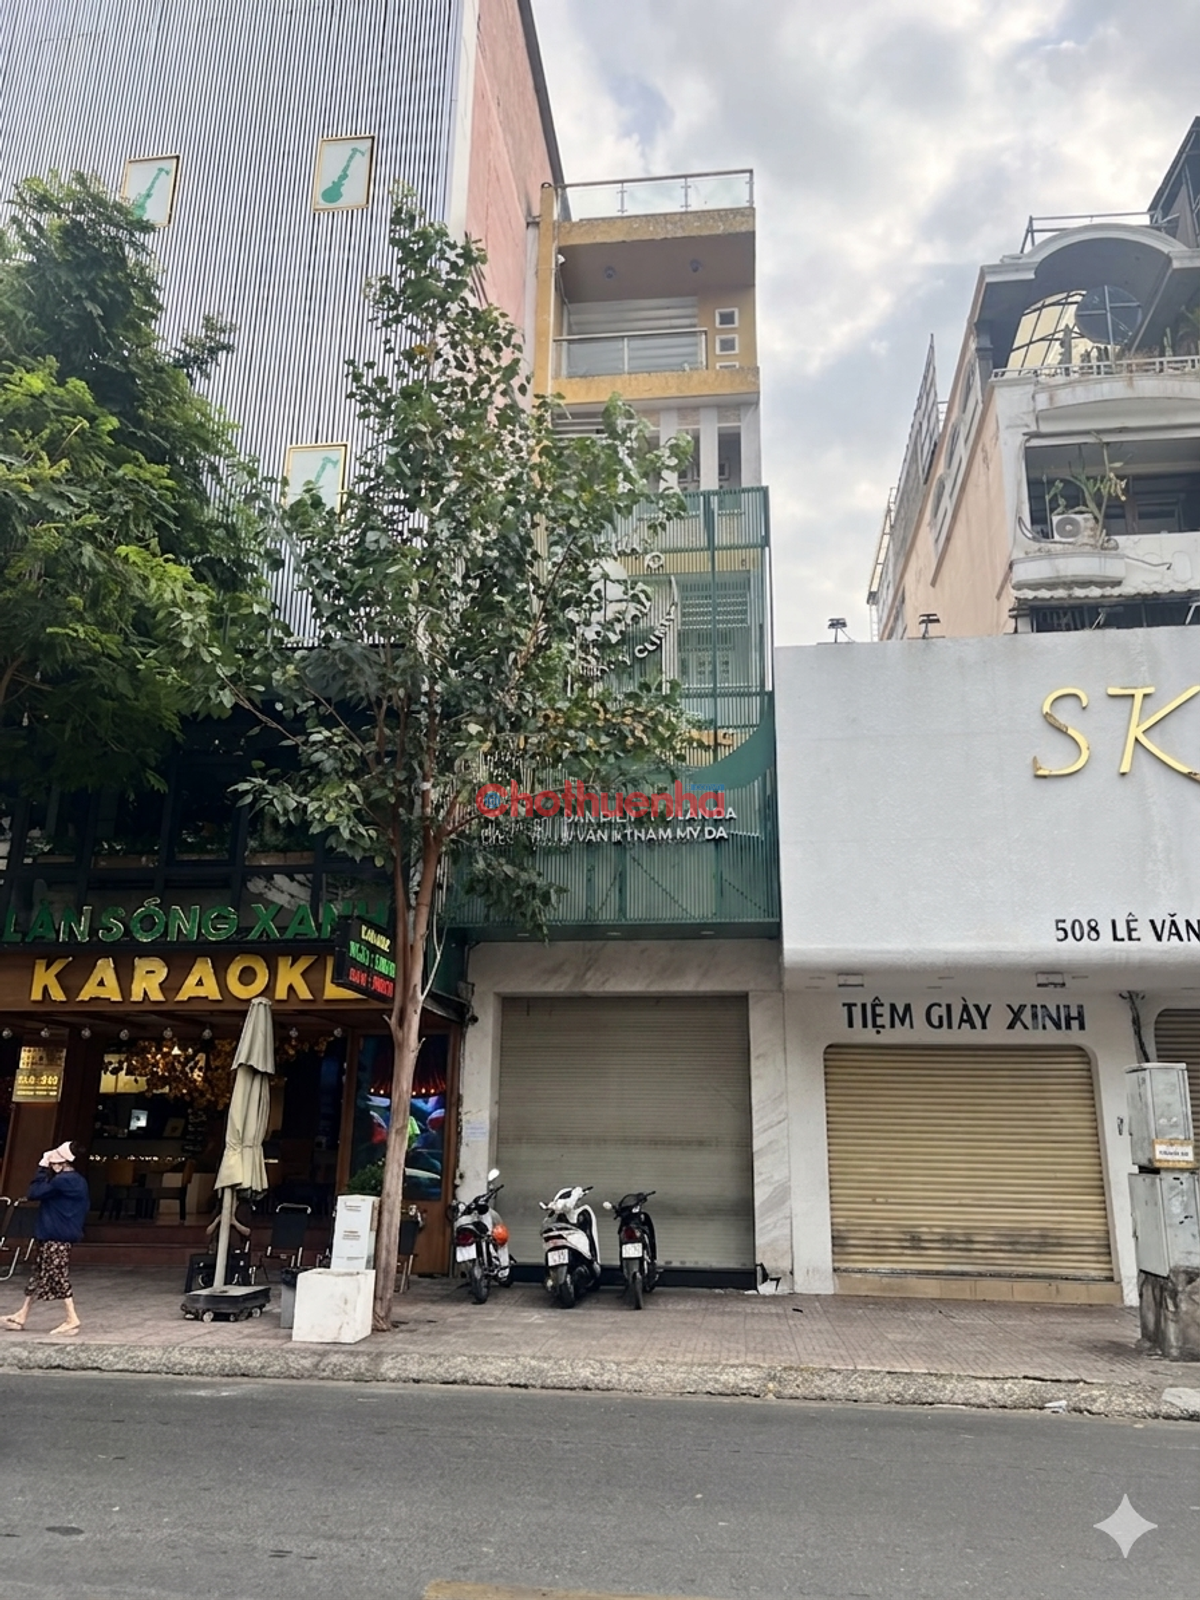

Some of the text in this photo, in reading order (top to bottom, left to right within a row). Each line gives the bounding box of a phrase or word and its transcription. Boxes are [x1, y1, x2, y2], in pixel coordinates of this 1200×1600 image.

[1054, 912, 1200, 942] 508 LÊ VĂN
[842, 996, 1087, 1035] TIỆM GIÀY XINH
